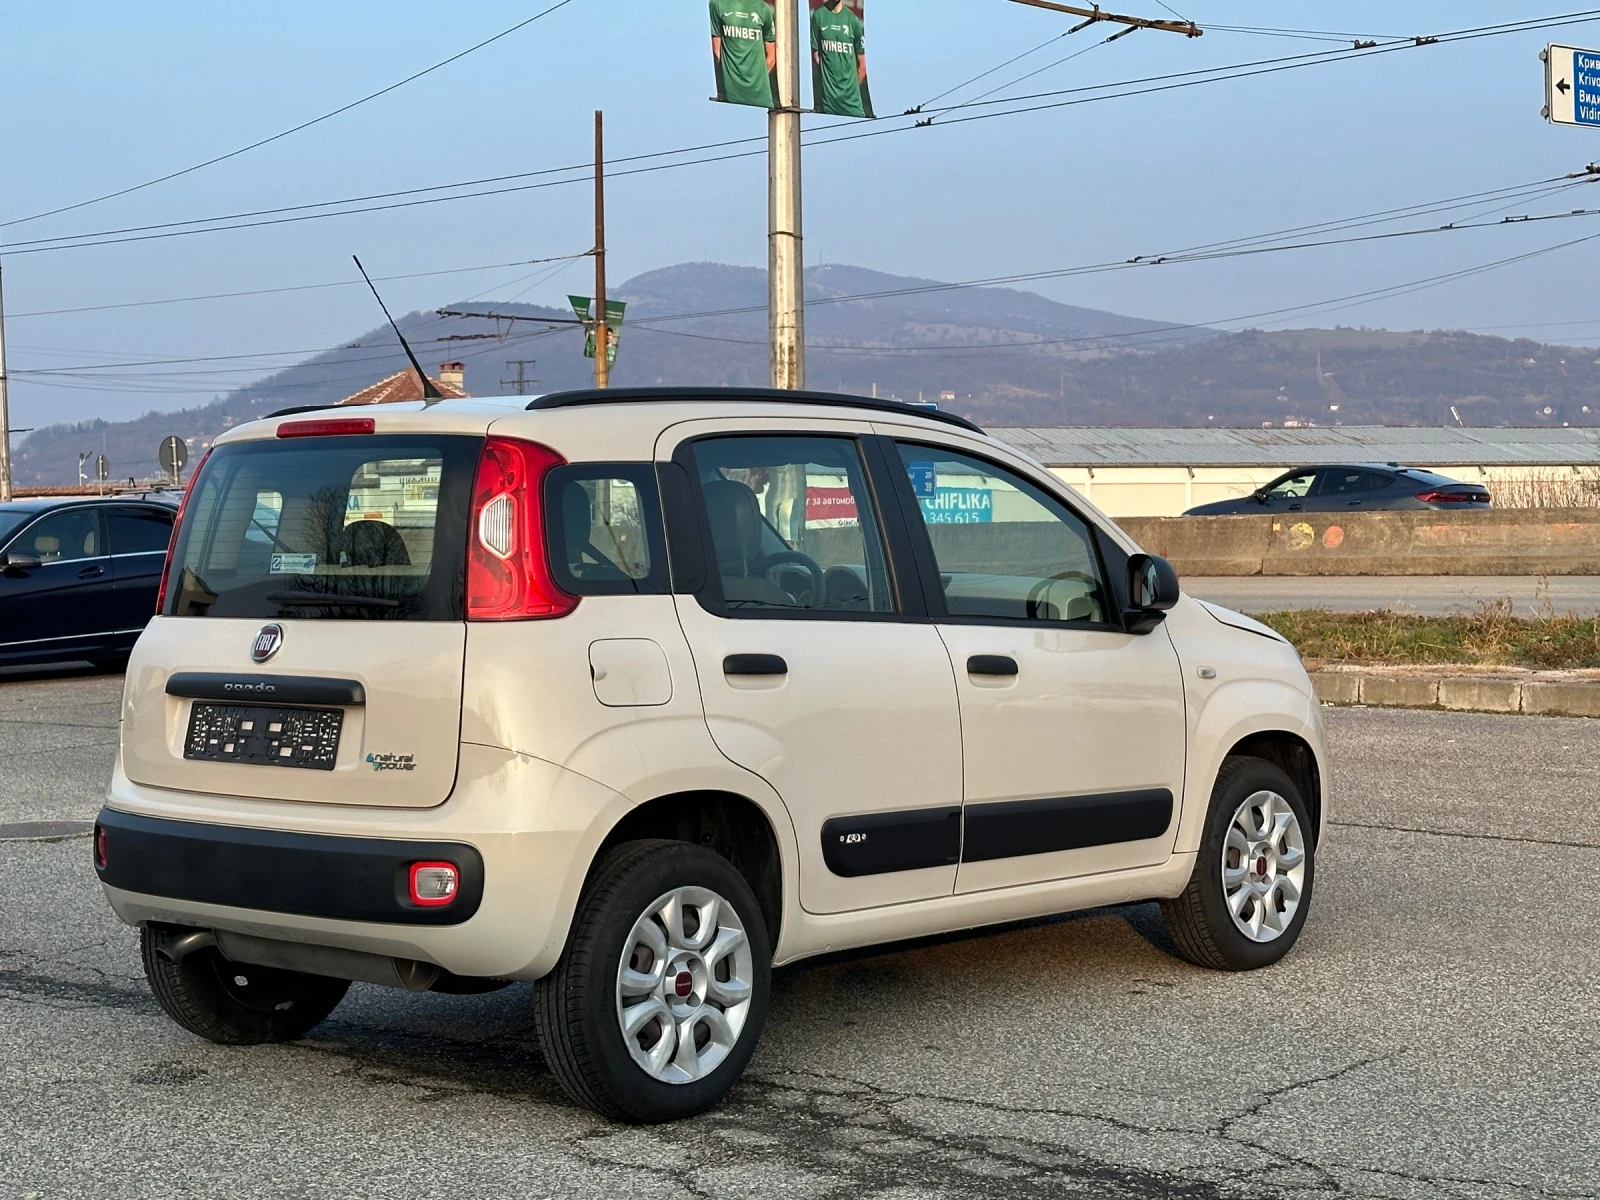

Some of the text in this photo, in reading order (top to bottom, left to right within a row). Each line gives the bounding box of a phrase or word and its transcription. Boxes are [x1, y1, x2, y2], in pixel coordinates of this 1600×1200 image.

[722, 25, 761, 41] WINBET
[821, 39, 853, 55] WINBET
[930, 512, 952, 524] 345
[954, 512, 979, 524] 615
[255, 634, 276, 651] FIAT
[374, 752, 415, 762] natural
